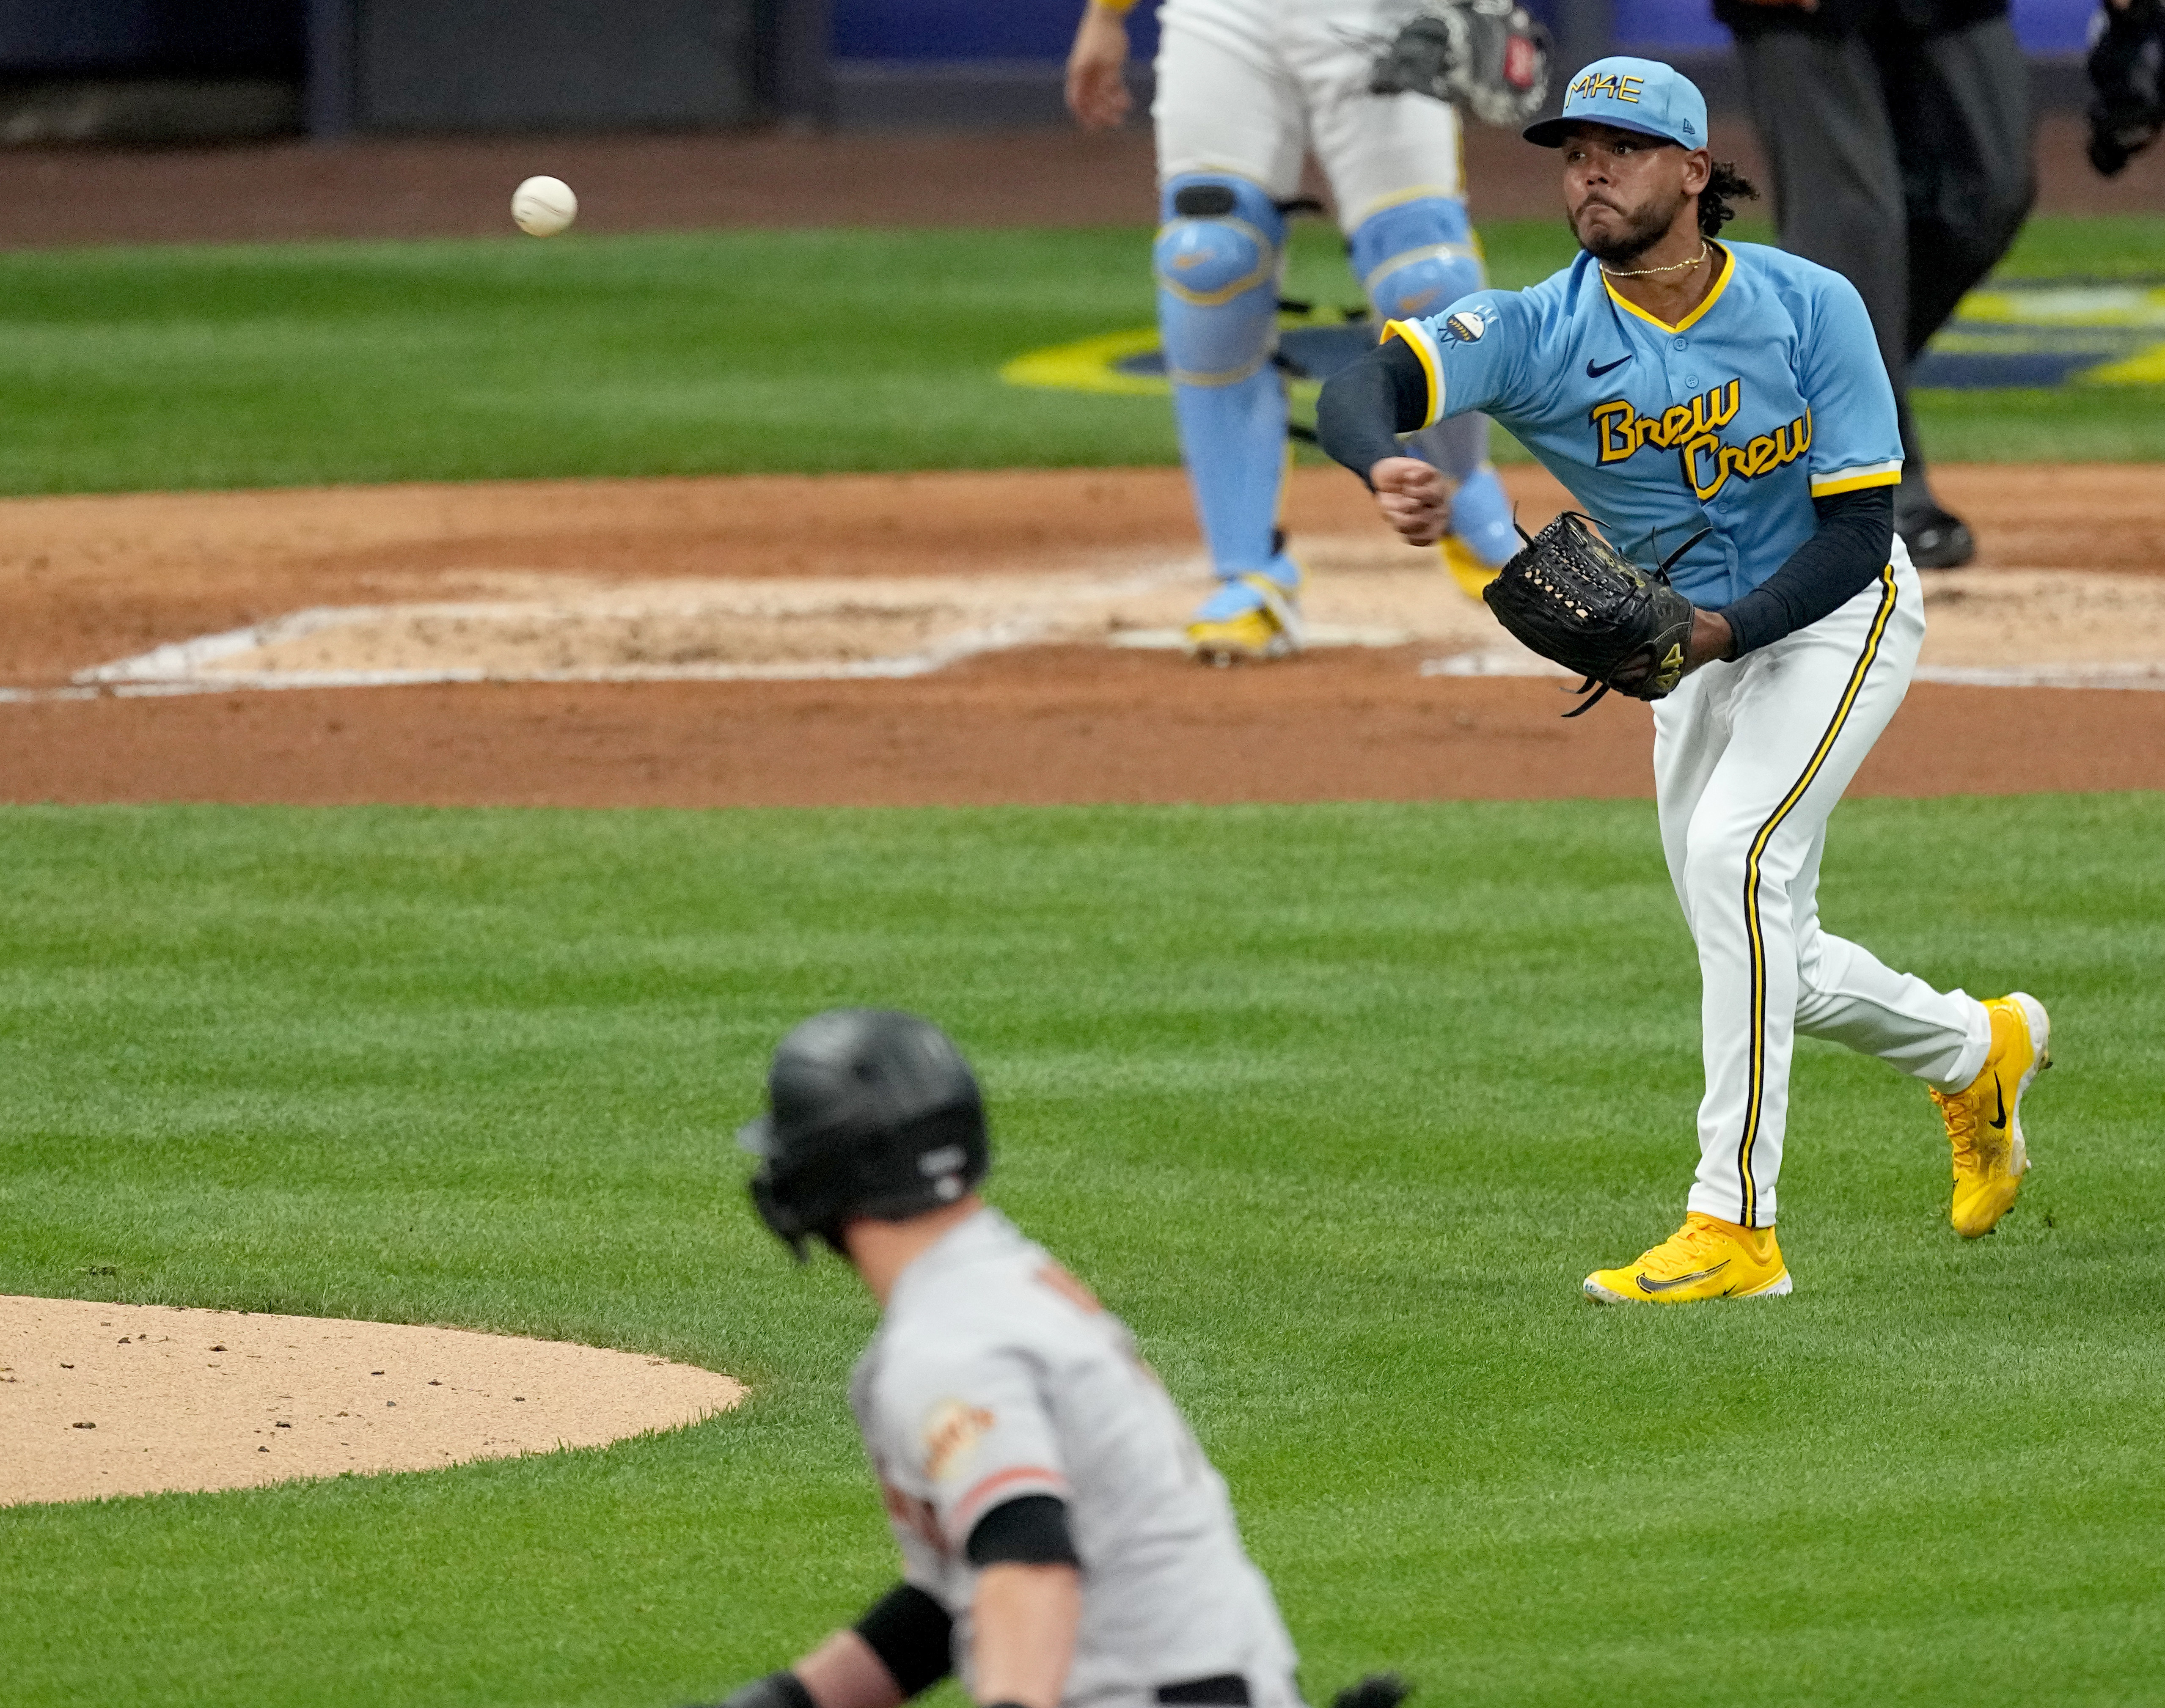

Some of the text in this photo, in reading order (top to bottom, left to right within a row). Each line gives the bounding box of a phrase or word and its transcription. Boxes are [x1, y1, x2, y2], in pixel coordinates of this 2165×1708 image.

[1565, 72, 1645, 109] MKE
[1589, 377, 1740, 467] Brew
[1678, 404, 1813, 503] Crew
